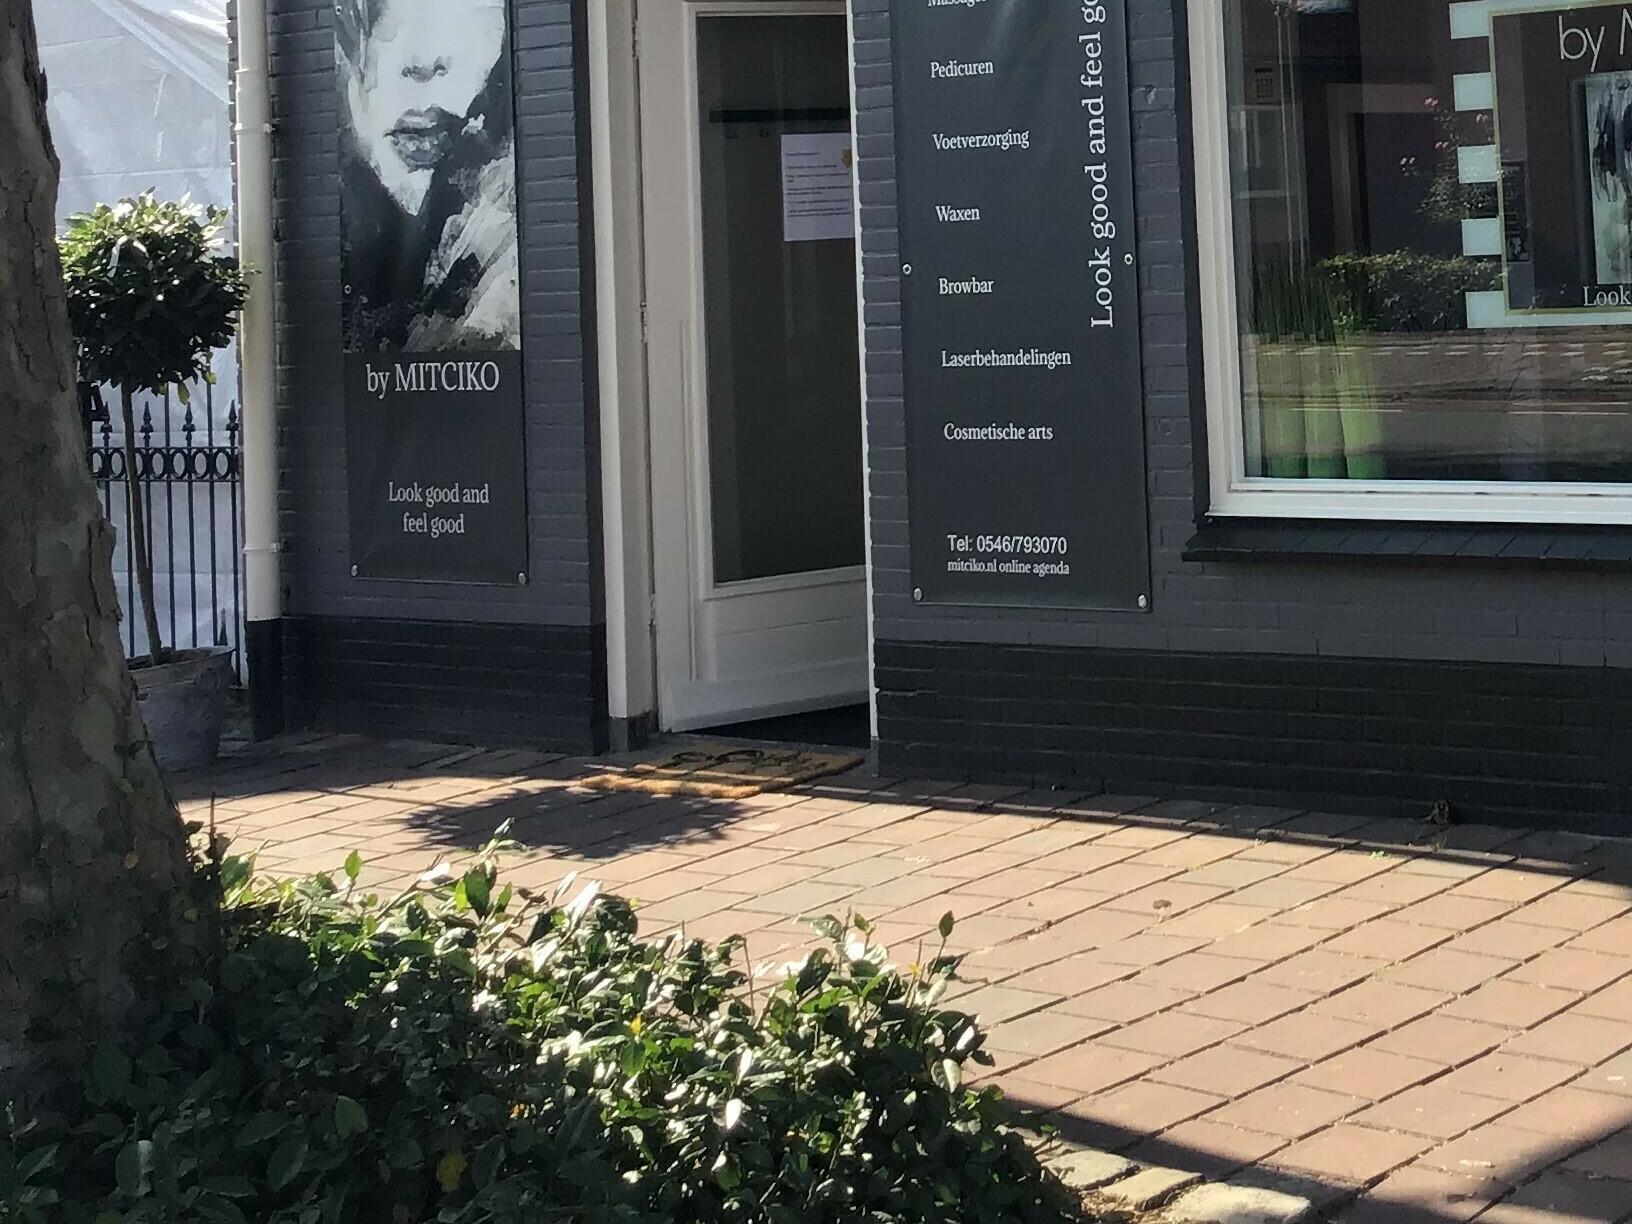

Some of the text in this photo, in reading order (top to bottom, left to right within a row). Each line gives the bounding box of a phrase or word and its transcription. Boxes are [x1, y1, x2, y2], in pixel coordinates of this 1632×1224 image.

[1558, 15, 1607, 72] by
[930, 59, 994, 80] Pedicuren
[1079, 32, 1103, 89] feel
[1081, 95, 1106, 155] and
[932, 129, 1031, 152] Voetverzorging
[1085, 162, 1116, 240] good
[935, 205, 981, 222] Waxen
[938, 277, 994, 295] Browbar
[1089, 245, 1115, 328] Look
[1583, 284, 1632, 307] Look
[941, 350, 1072, 370] Laserbehandelingen
[366, 361, 500, 400] by MITCIKO
[944, 422, 1054, 441] Cosmetische arts
[388, 481, 489, 508] Look good and
[403, 512, 465, 538] feel good
[947, 535, 1068, 554] Tel: 0546/793070
[947, 558, 1070, 577] mitciko.nl online agenda
